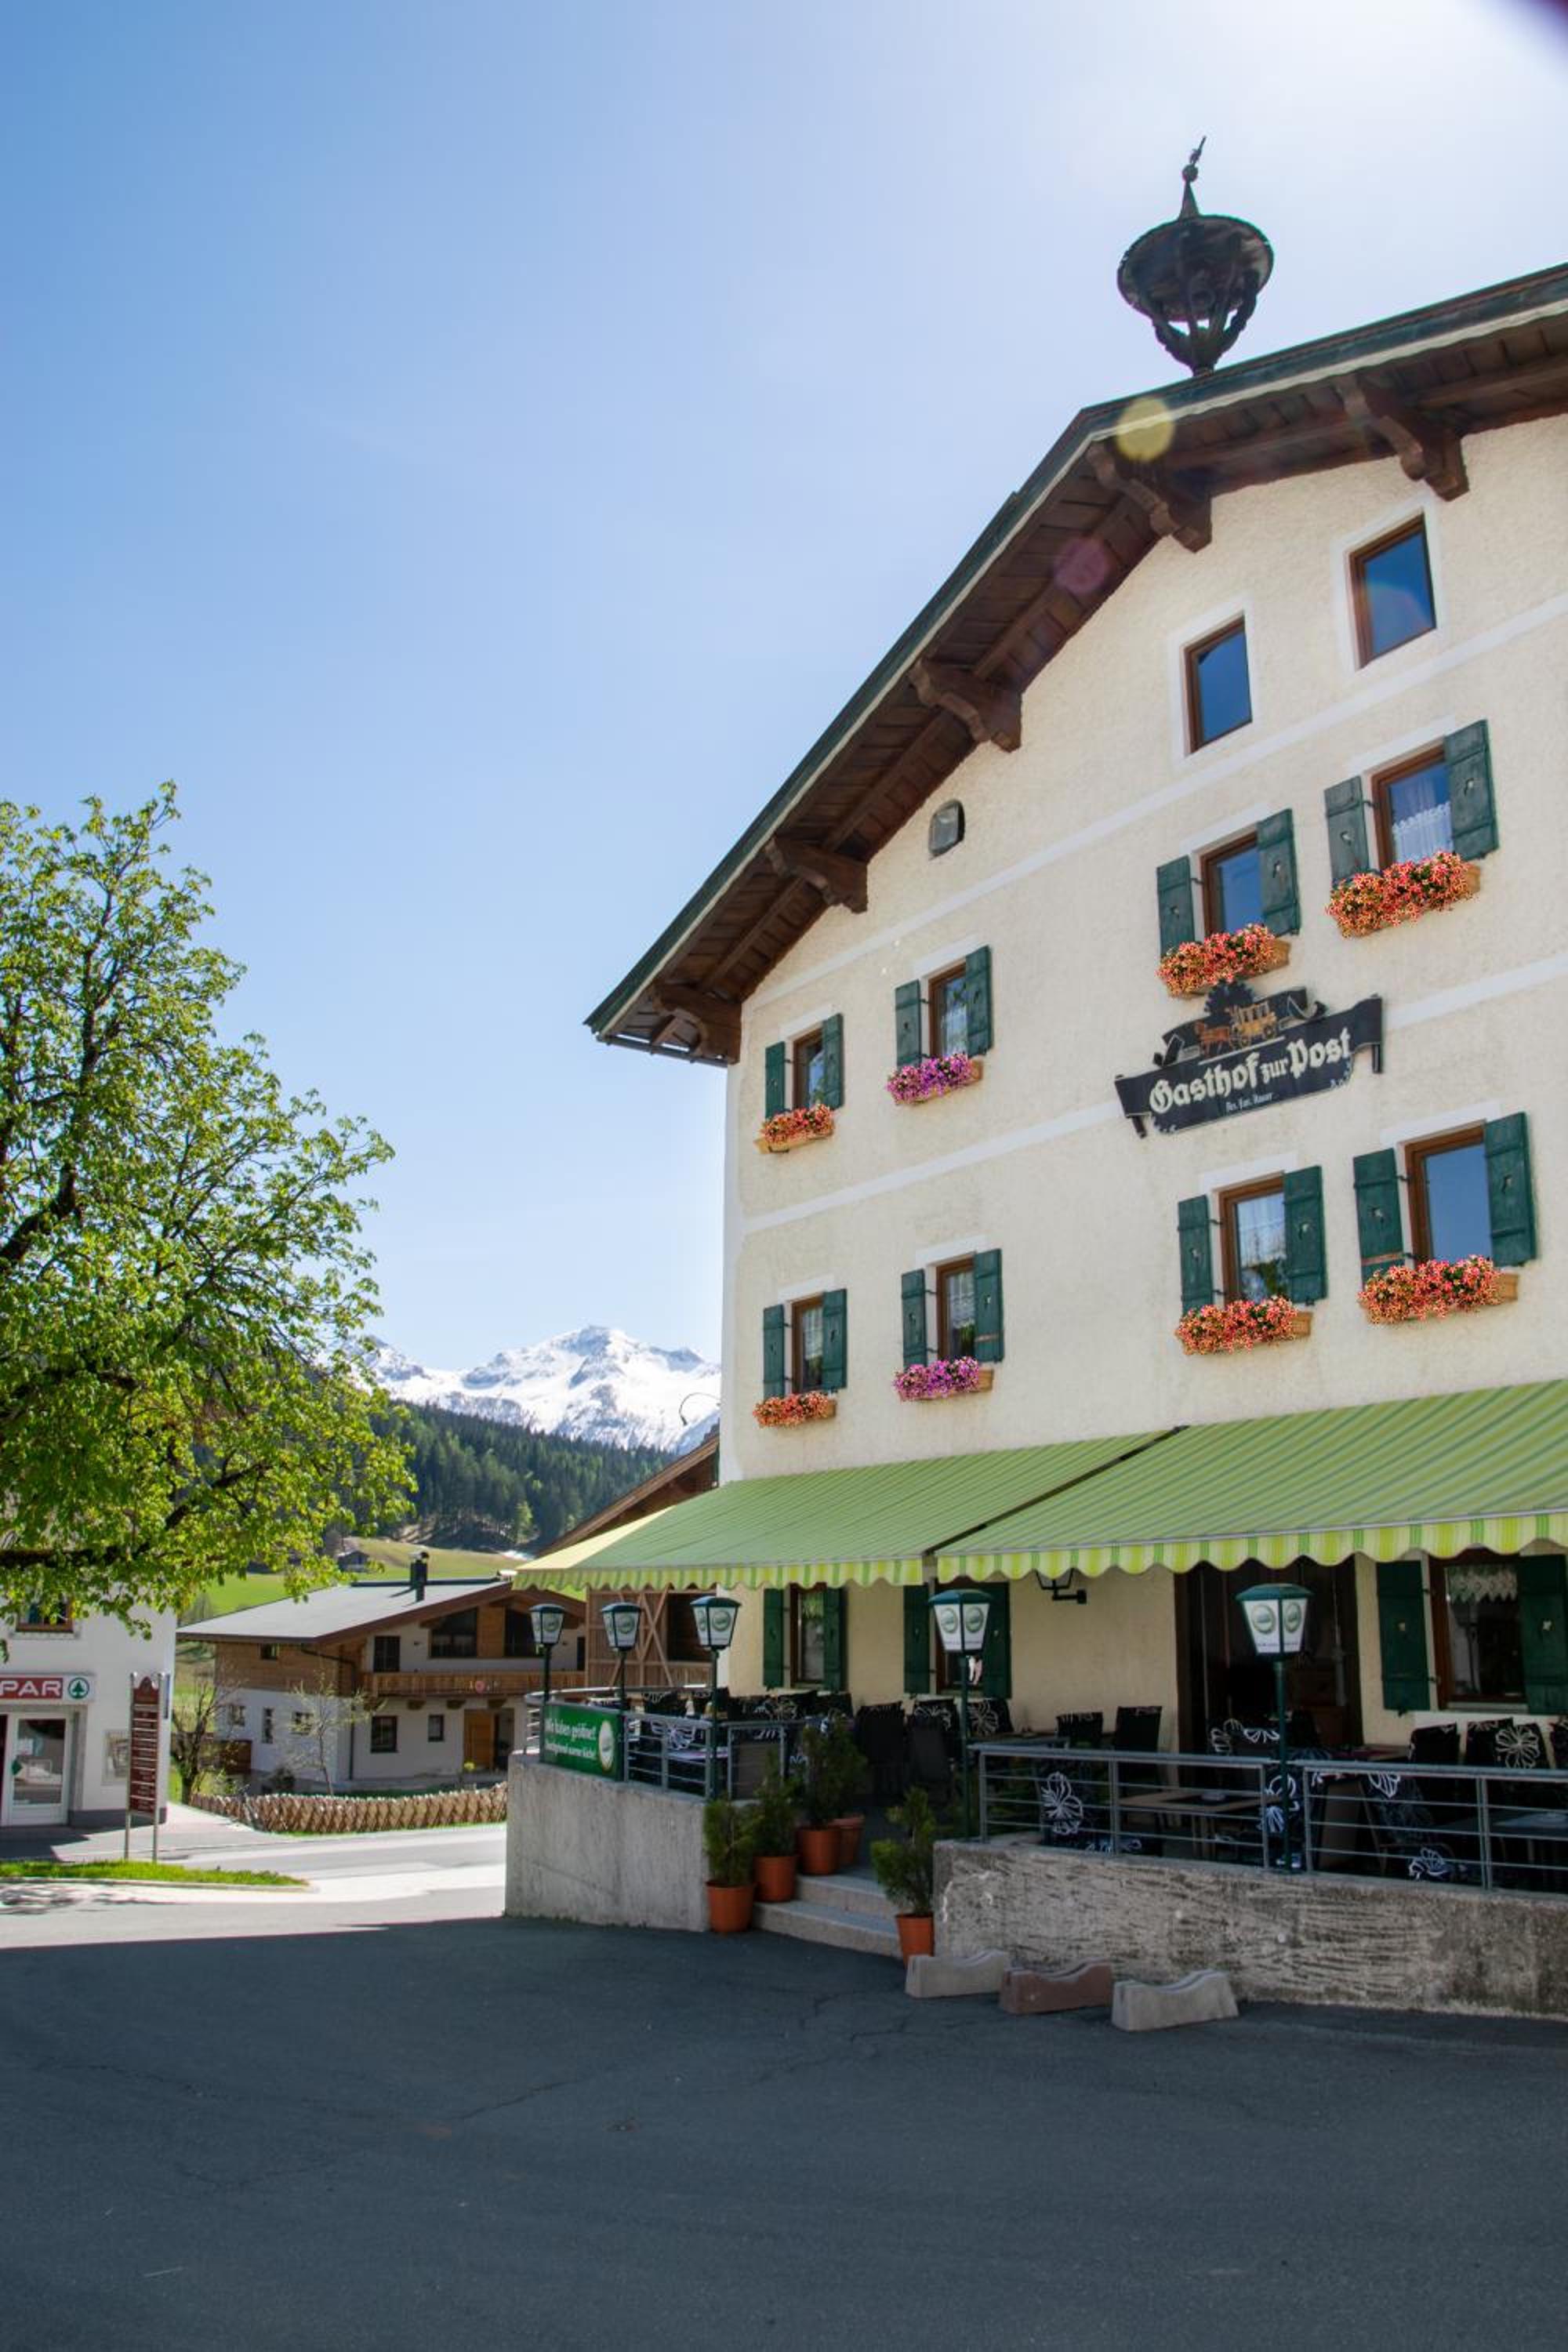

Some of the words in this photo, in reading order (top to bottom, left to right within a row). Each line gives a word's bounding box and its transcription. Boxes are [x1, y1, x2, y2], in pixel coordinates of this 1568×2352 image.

[1149, 1052, 1260, 1112] Gasthof
[1260, 1058, 1288, 1083] zur
[1287, 1027, 1351, 1079] Post
[0, 1680, 62, 1696] PAR
